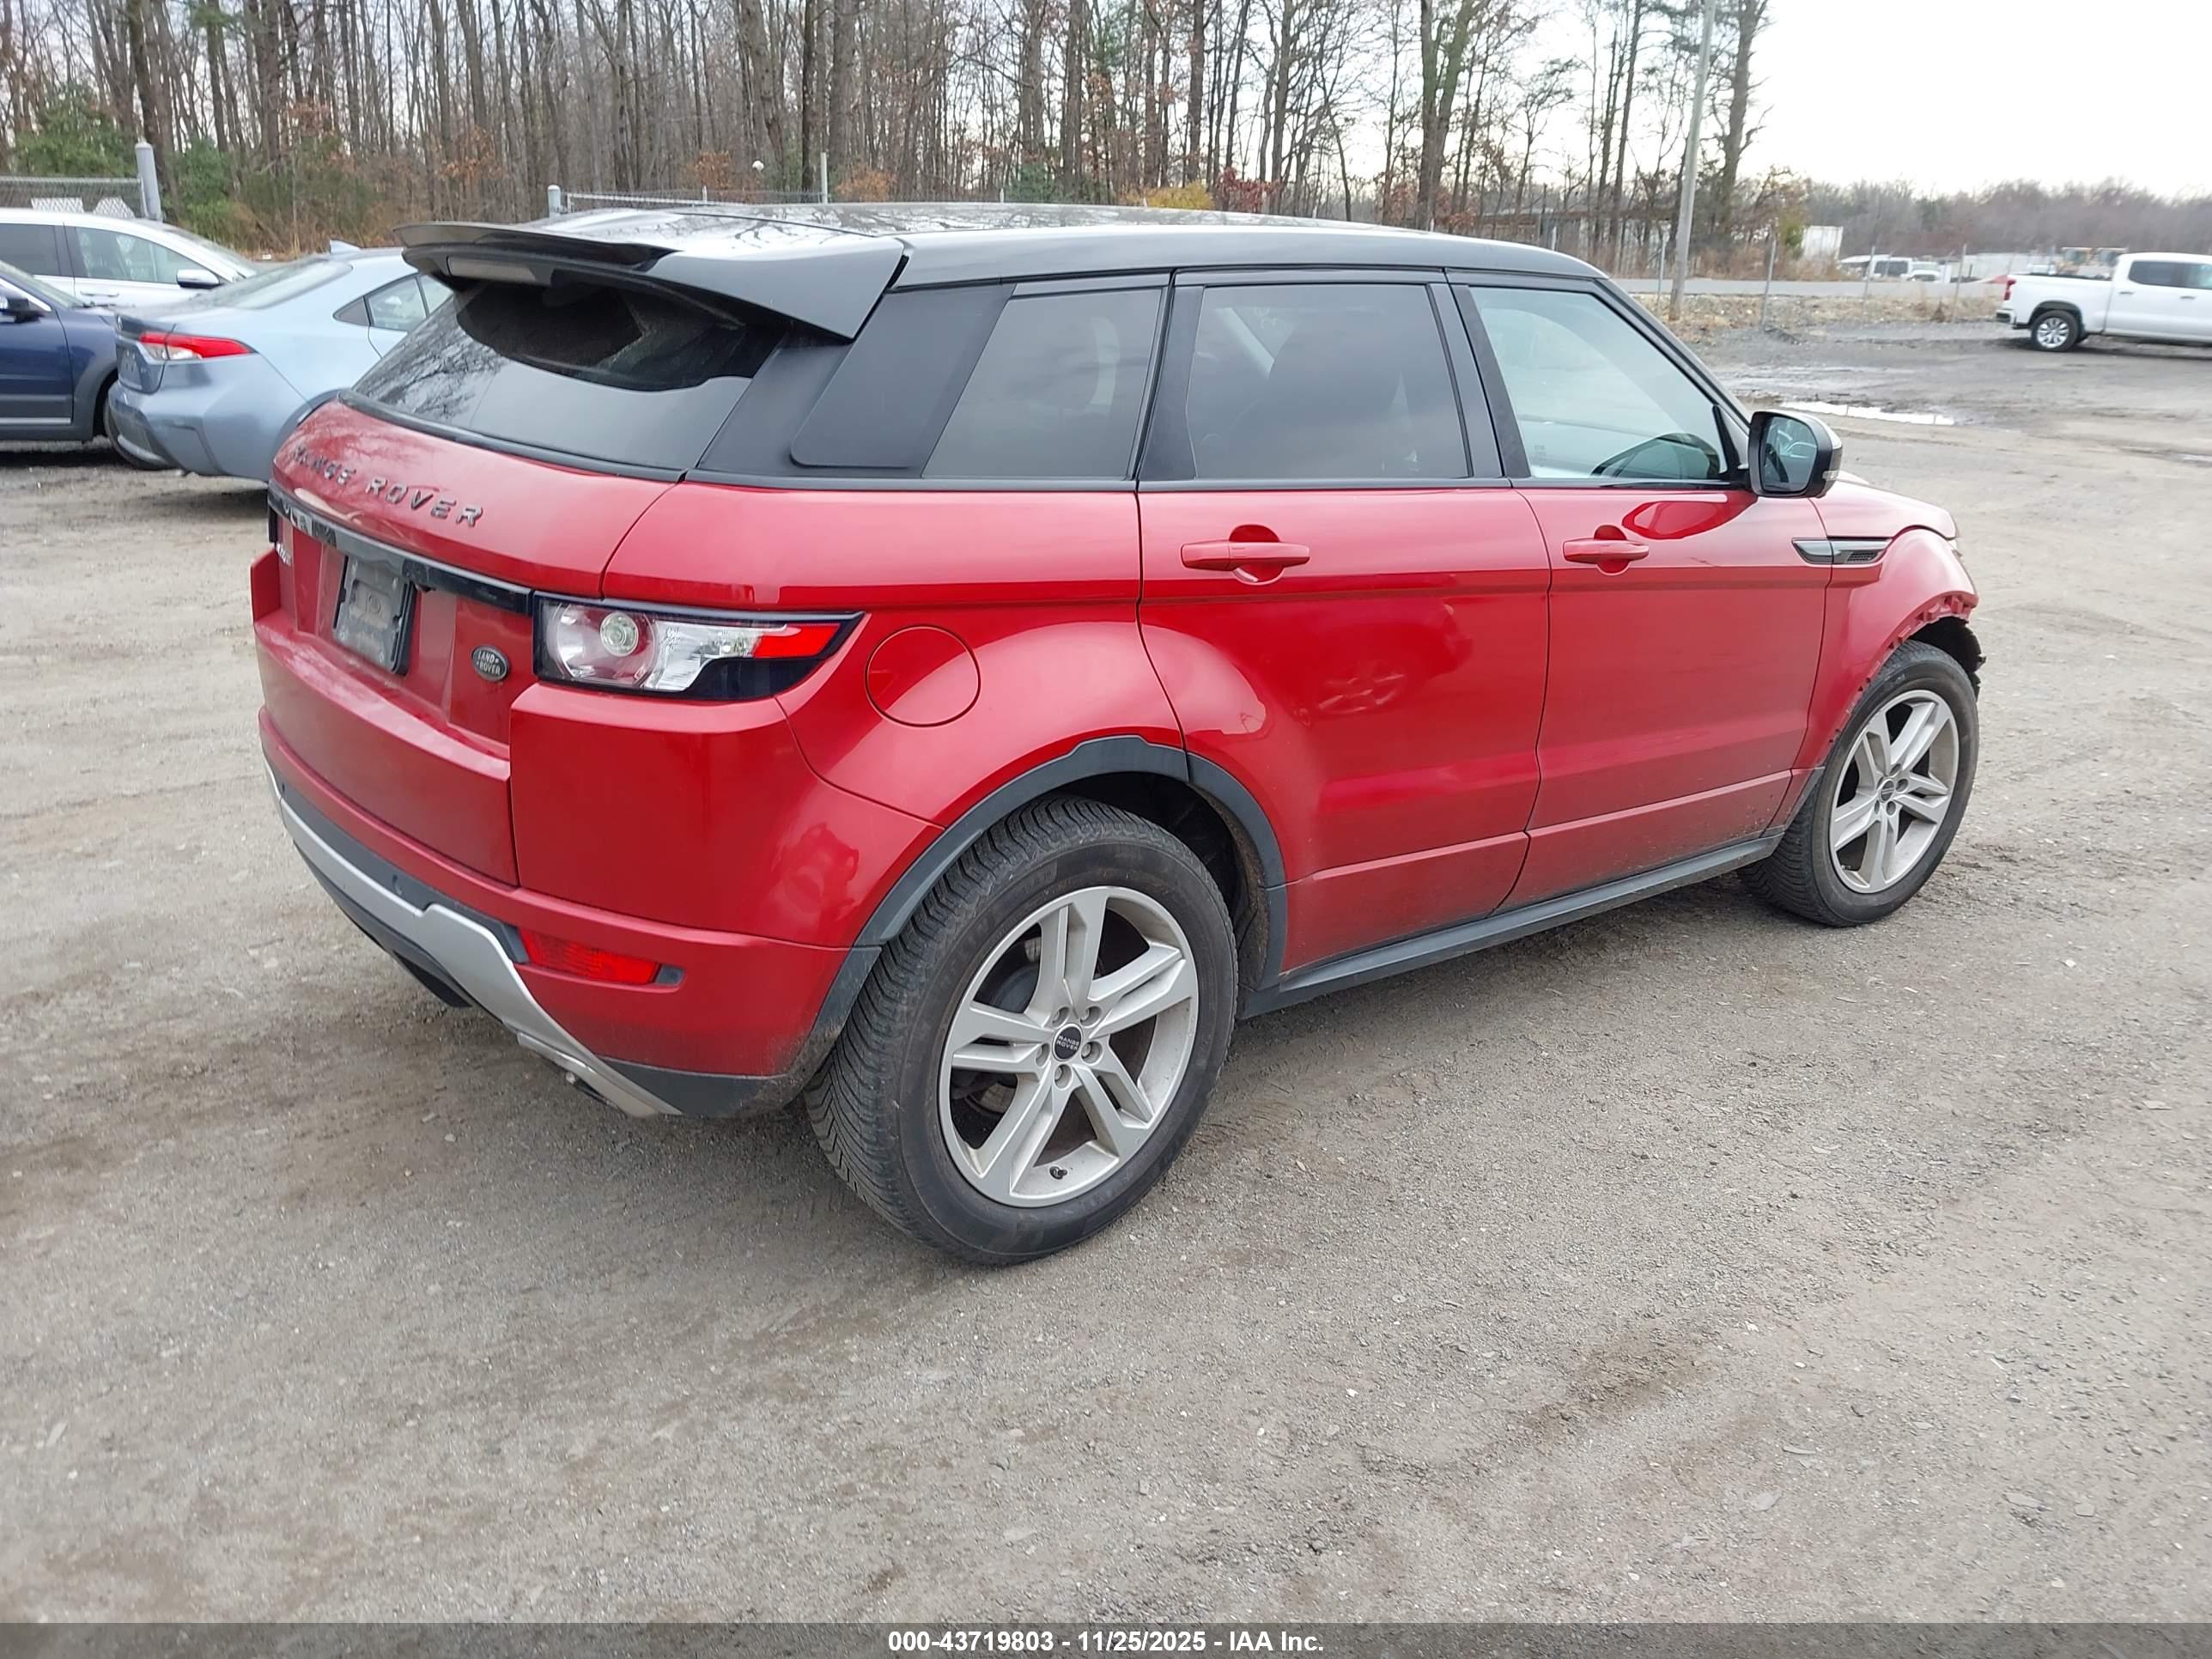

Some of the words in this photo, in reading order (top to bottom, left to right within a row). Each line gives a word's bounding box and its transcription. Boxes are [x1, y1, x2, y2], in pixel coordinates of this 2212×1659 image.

[366, 476, 483, 527] ROVER
[477, 650, 495, 664] LAND
[480, 660, 501, 676] ROVER
[1056, 1040, 1078, 1051] ROVER
